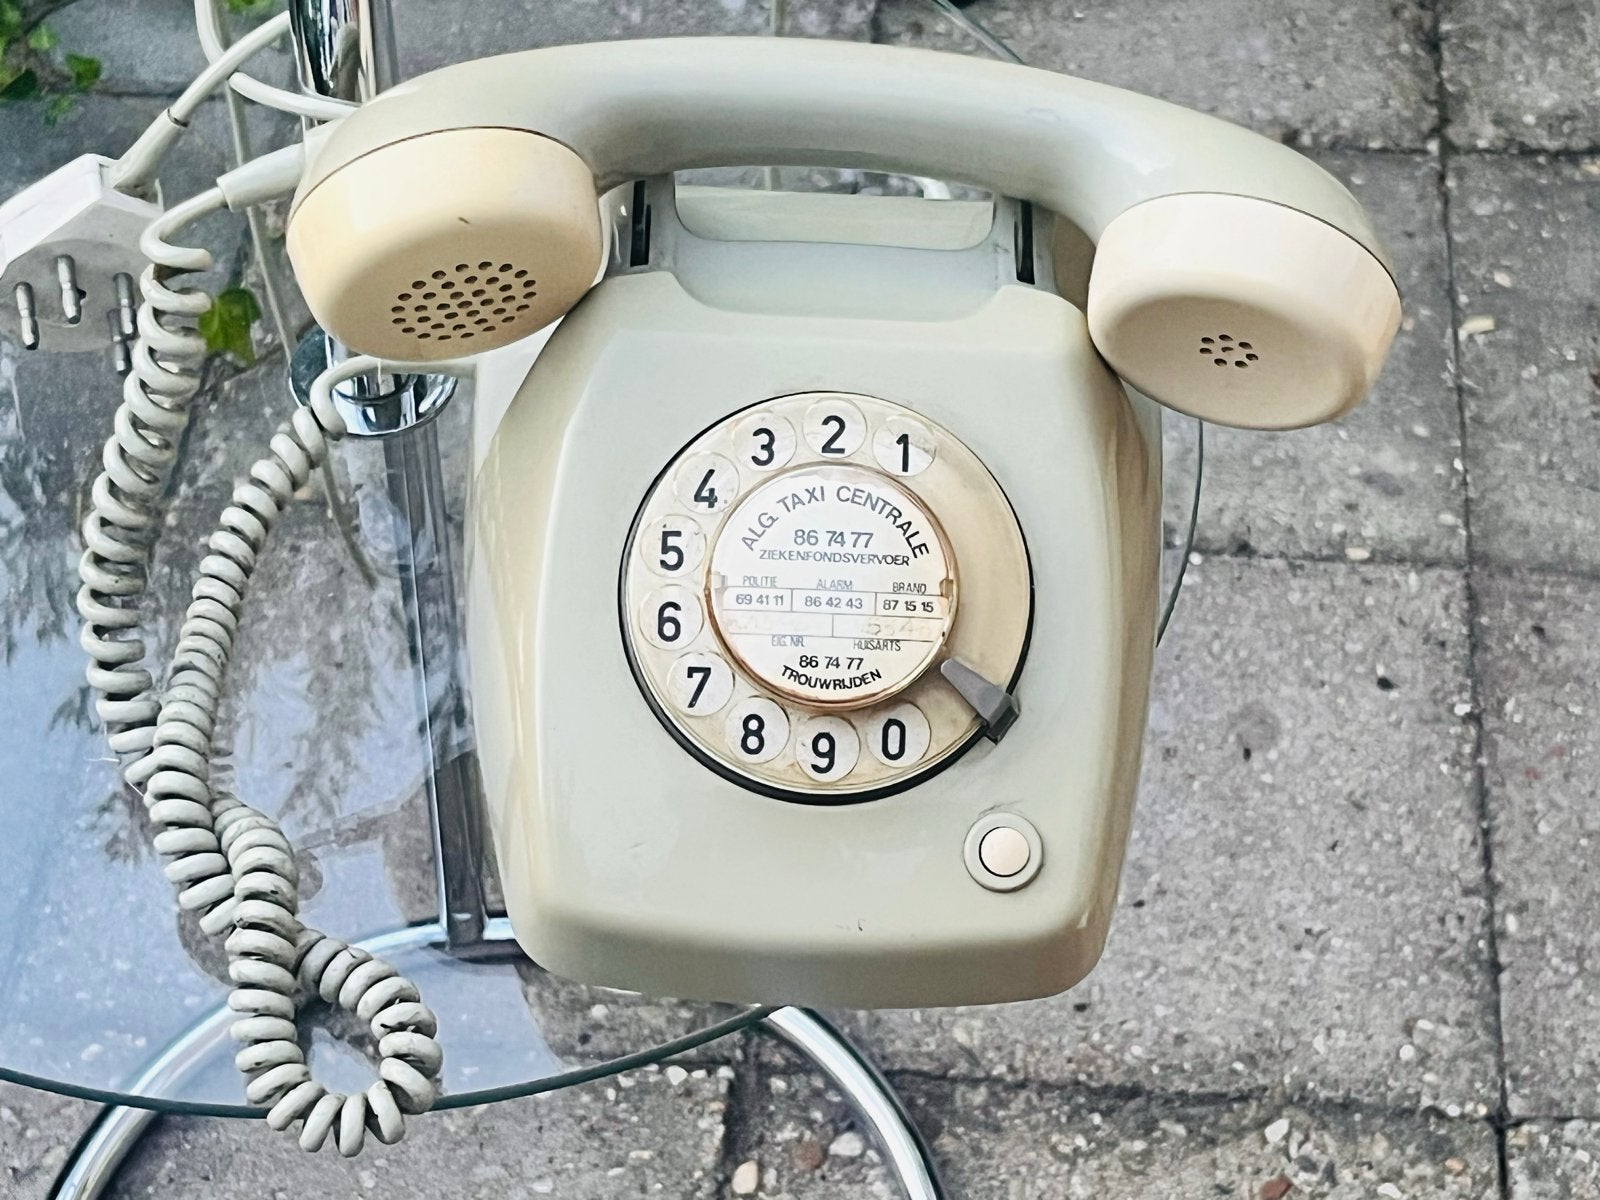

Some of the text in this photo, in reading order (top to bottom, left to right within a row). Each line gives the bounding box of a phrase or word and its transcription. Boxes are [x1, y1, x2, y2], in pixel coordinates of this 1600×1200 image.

[751, 427, 775, 466] 3
[821, 415, 845, 454] 2
[895, 433, 909, 472] 1
[693, 468, 718, 508] 4
[776, 485, 825, 512] TAXI
[836, 485, 930, 559] CENTRALE
[793, 528, 874, 548] 86 74 77
[659, 530, 684, 571] 5
[759, 549, 910, 566] ZIEKENFONDSVERVOER
[742, 575, 778, 588] POLITIE
[816, 579, 853, 591] ALARM
[892, 581, 927, 594] BRAND
[736, 593, 784, 606] 69 41 11
[804, 595, 863, 610] 86 42 43
[883, 599, 934, 613] 87 15 15
[657, 601, 682, 643] 6
[853, 640, 902, 652] HUISARTS
[781, 664, 882, 691] TROUWRIJDEN
[799, 655, 864, 671] 86 74 77
[686, 666, 712, 709] 7
[740, 714, 765, 755] 8
[882, 718, 907, 761] 0
[811, 731, 837, 775] 9
